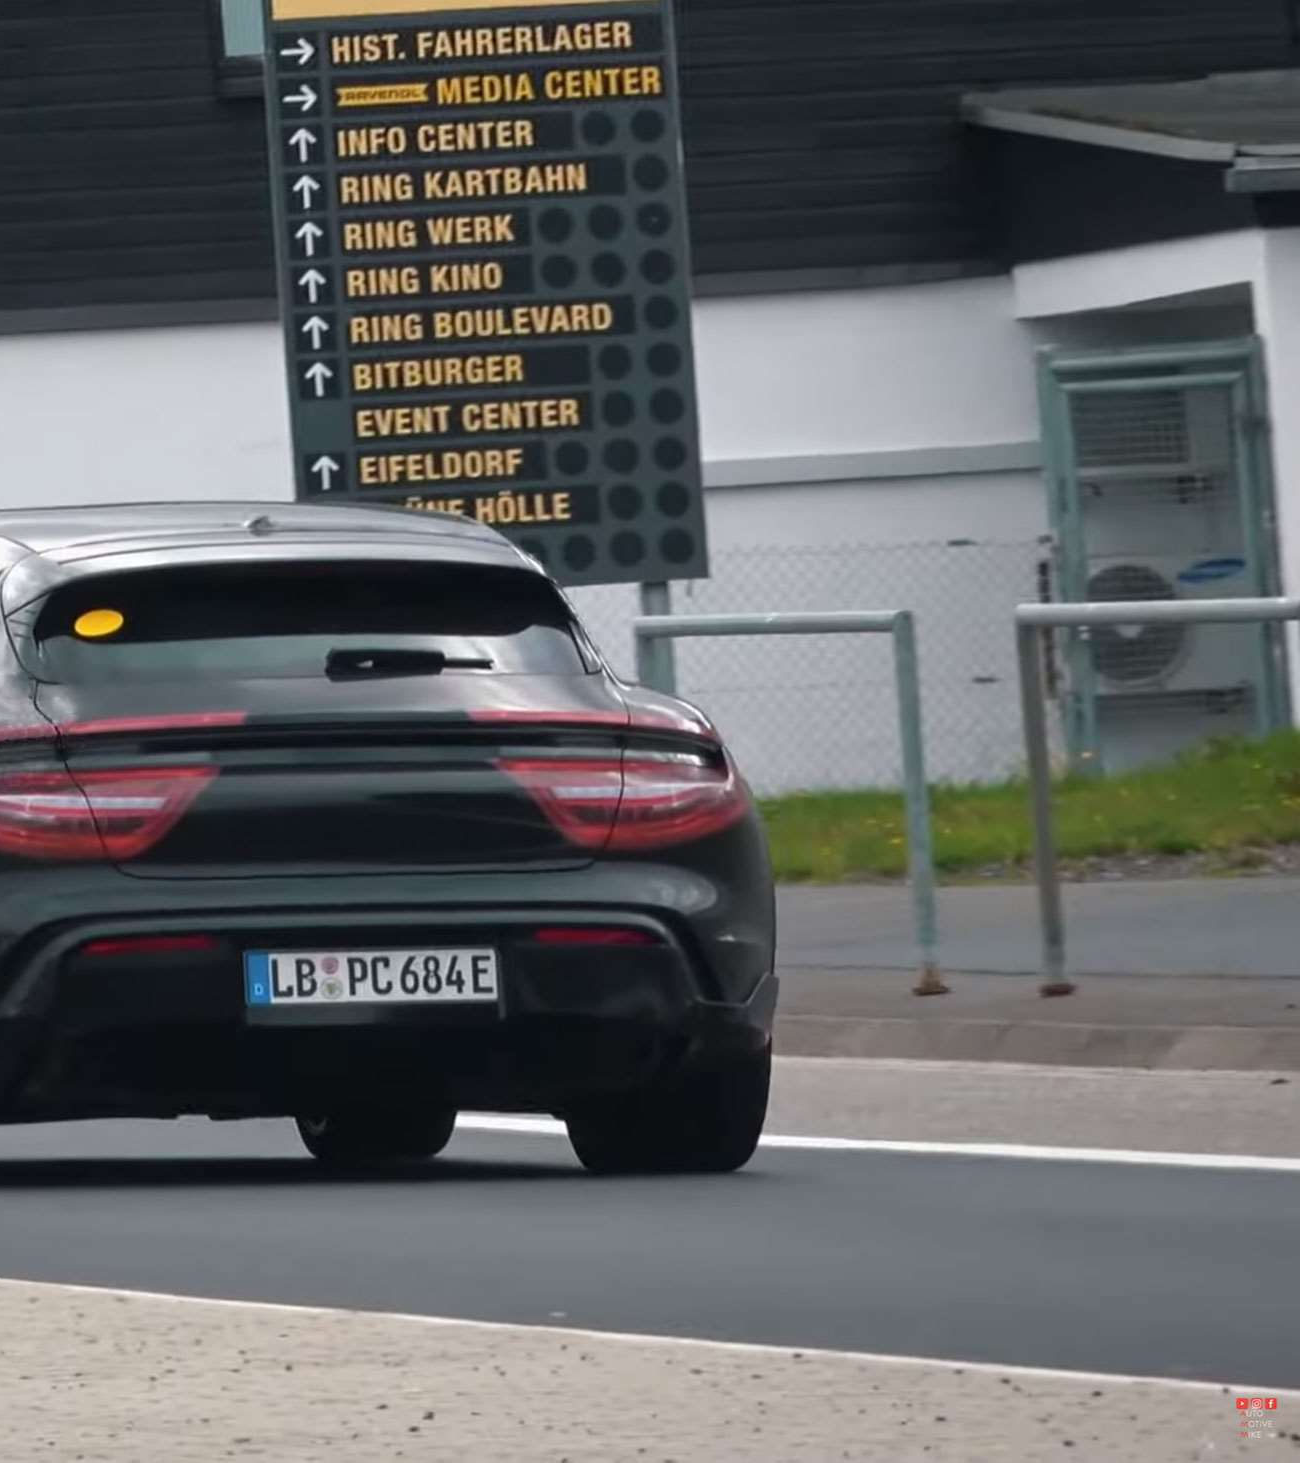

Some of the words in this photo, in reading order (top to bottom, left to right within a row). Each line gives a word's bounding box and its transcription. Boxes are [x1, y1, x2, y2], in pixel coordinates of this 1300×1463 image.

[331, 33, 406, 64] HIST.
[417, 21, 633, 60] FAHRERLAGER
[436, 72, 536, 106] MEDIA
[545, 66, 663, 100] CENTER
[337, 126, 407, 158] INFO
[417, 119, 534, 152] CENTER
[340, 173, 414, 205] RING
[424, 163, 588, 200] KARTBAHN
[343, 220, 417, 251] RING
[427, 214, 516, 245] WERK
[346, 266, 420, 298] RING
[431, 261, 502, 292] KINO
[349, 314, 423, 344] RING
[433, 303, 613, 339] BOULEVARD
[353, 354, 524, 391] BITBURGER
[356, 405, 452, 438] EVENT
[462, 399, 581, 432] CENTER
[360, 448, 523, 485] EIFELDORF
[476, 490, 573, 524] HÖLLE
[271, 957, 318, 999] LB
